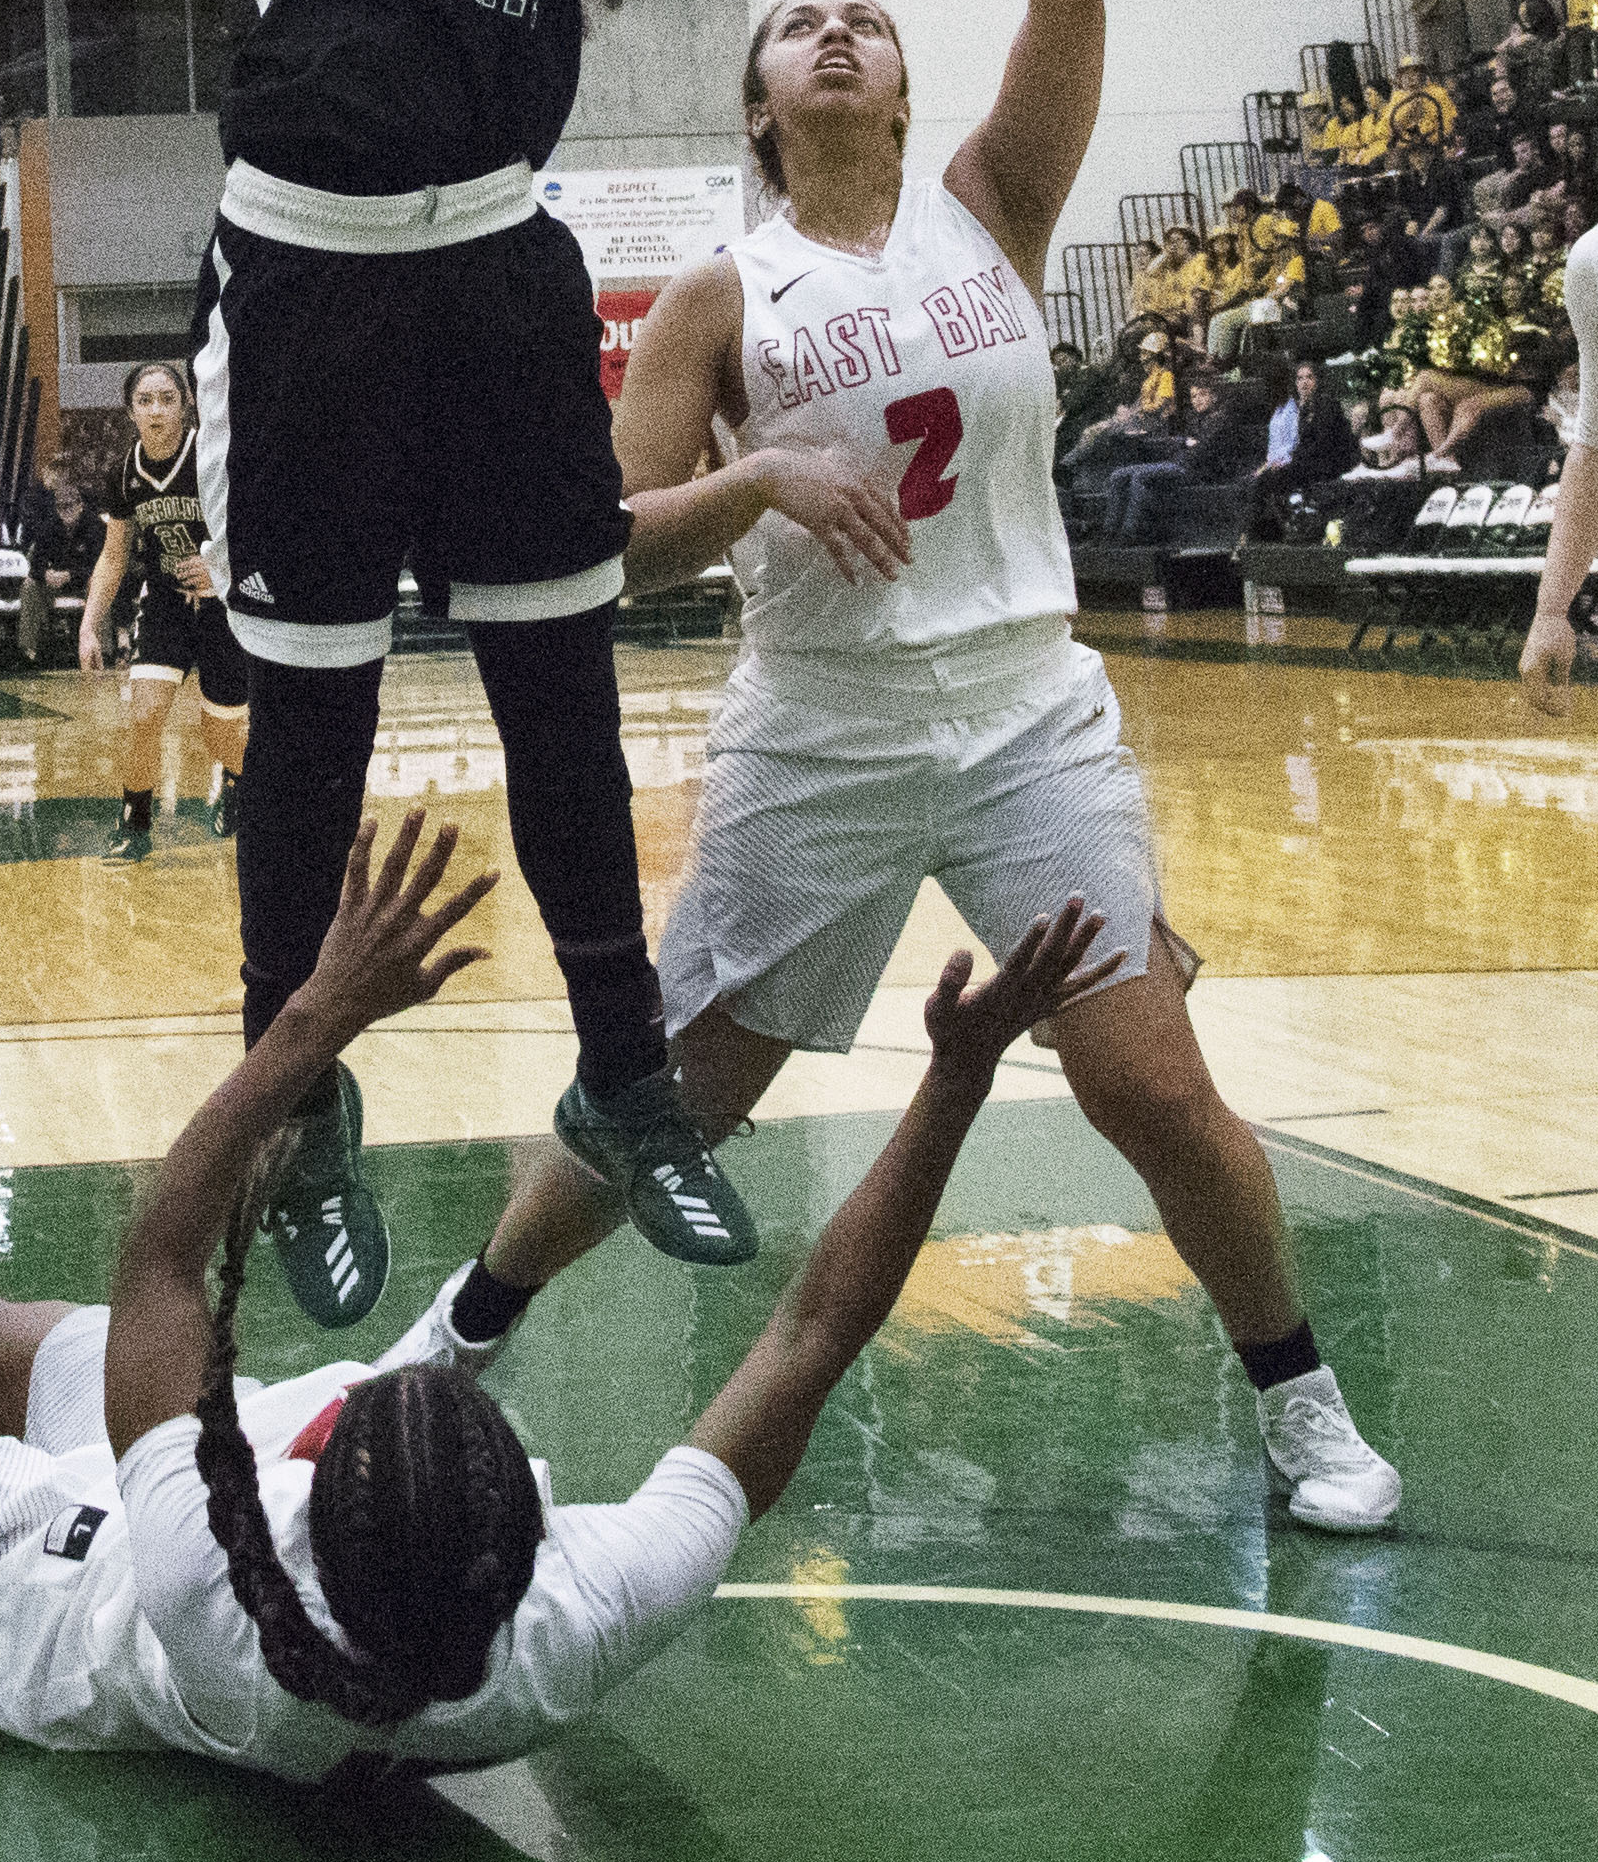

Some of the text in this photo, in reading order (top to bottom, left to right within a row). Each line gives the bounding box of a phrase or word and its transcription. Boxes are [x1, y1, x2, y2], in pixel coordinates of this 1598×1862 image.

[756, 266, 1028, 409] EAST BAY
[882, 385, 964, 522] 2
